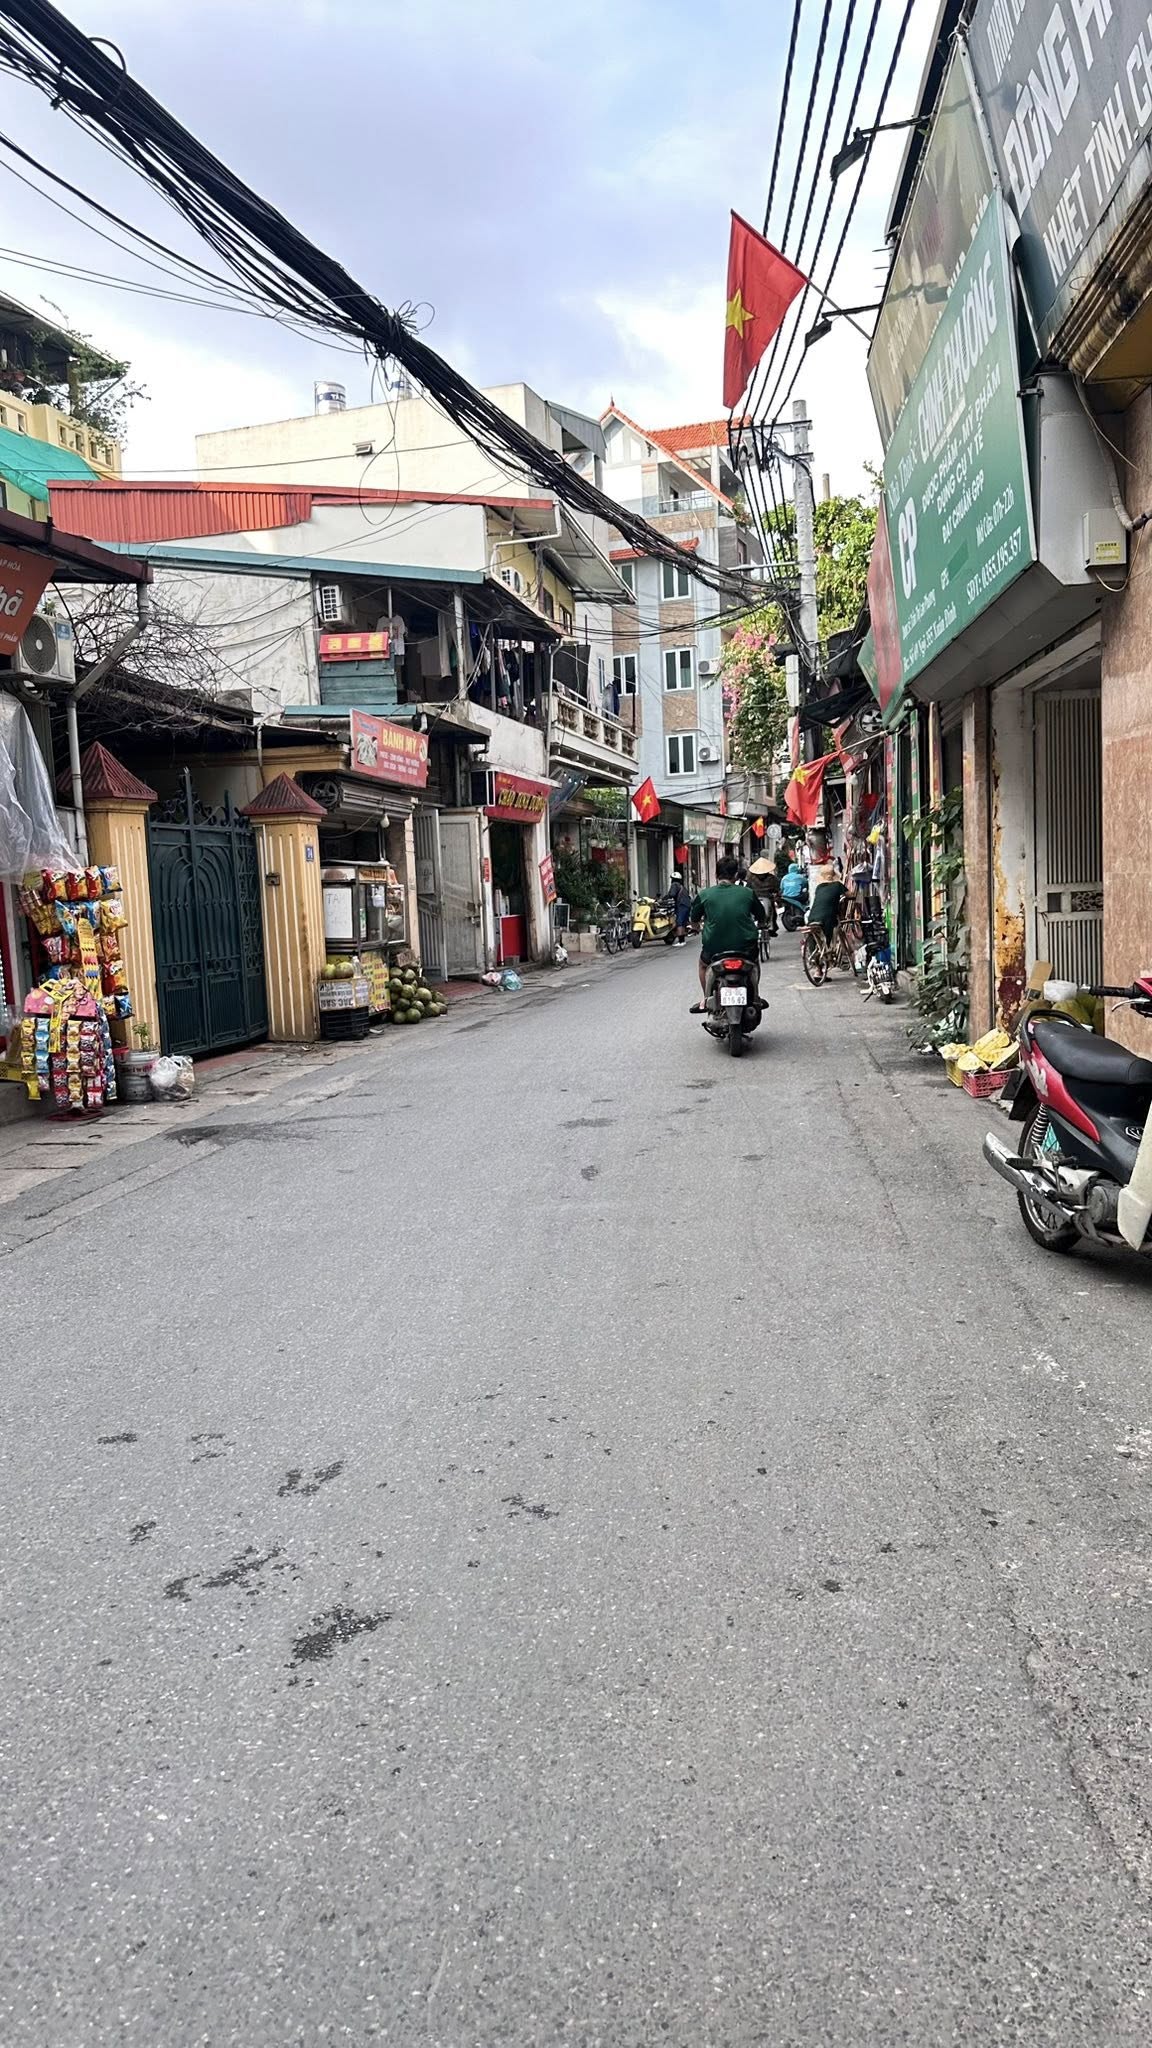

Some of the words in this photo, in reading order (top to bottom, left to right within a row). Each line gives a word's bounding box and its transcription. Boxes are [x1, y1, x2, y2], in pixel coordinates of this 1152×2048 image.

[944, 250, 998, 411] PHƯƠNG
[922, 473, 939, 513] DƯỢC
[938, 434, 958, 484] PHẨM
[961, 405, 974, 443] MỸ
[975, 363, 1001, 421] PHẨM
[936, 473, 956, 516] DỤNG
[956, 453, 967, 484] CỤ
[967, 446, 974, 465] Y
[974, 422, 984, 455] TẾ
[972, 469, 985, 501] GPP
[898, 497, 918, 600] CP
[966, 573, 982, 605] SĐT:
[981, 526, 1022, 589] 0355.195.357
[382, 727, 404, 749] BÁNH
